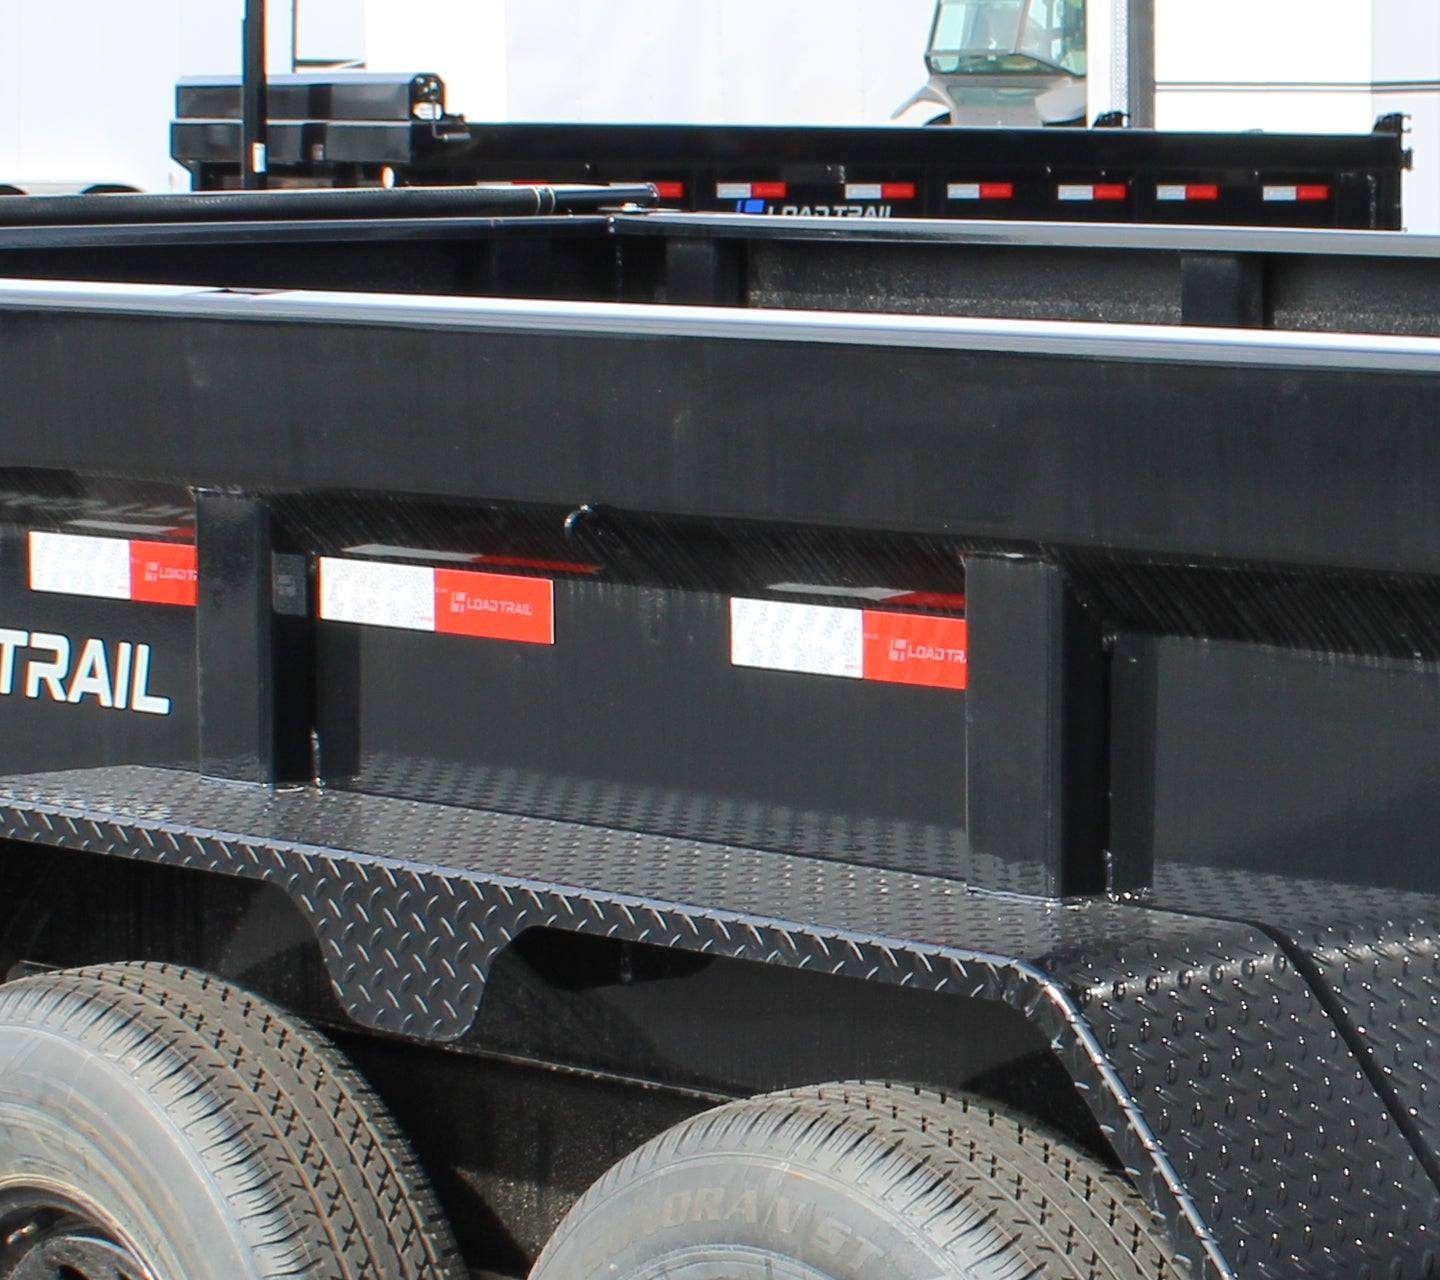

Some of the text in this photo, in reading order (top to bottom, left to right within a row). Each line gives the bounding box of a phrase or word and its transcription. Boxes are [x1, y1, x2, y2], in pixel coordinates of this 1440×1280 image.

[467, 597, 534, 617] LOAD TRAIL
[908, 645, 945, 662] LOAD
